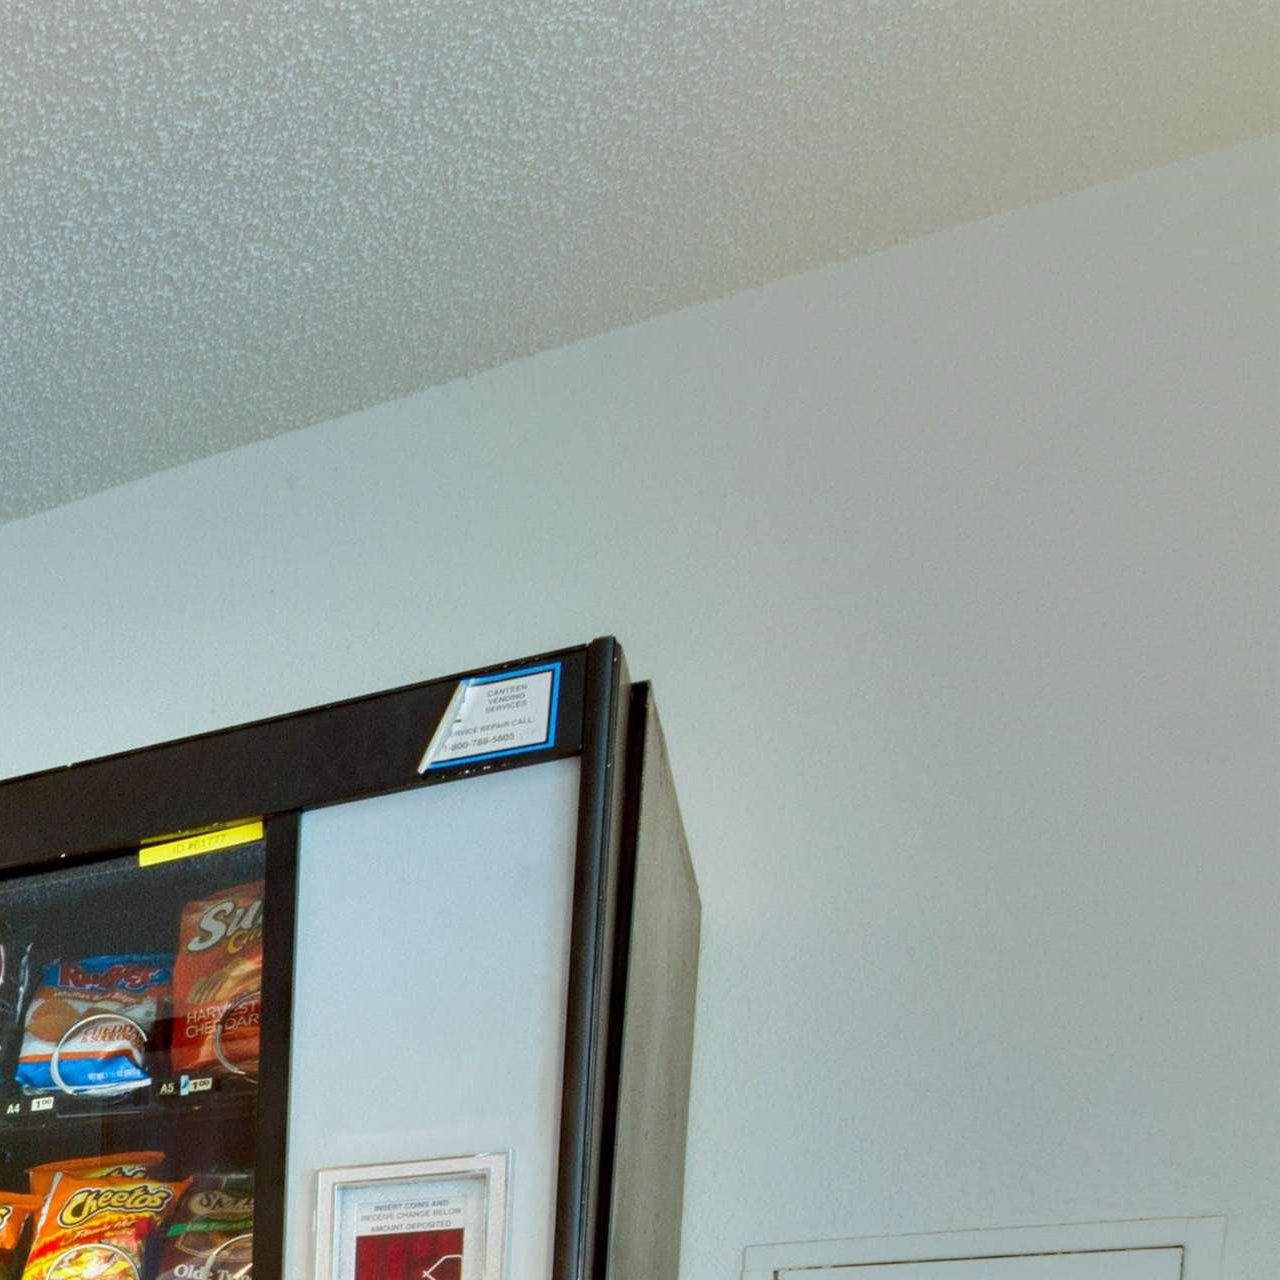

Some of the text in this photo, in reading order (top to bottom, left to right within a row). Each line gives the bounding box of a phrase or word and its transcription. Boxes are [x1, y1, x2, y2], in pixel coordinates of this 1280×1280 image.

[186, 1001, 260, 1025] HARVST
[160, 1082, 175, 1095] A5
[6, 1103, 21, 1114] A4
[57, 1184, 173, 1228] Cheetos
[404, 1200, 430, 1210] COINS
[432, 1199, 449, 1208] AND
